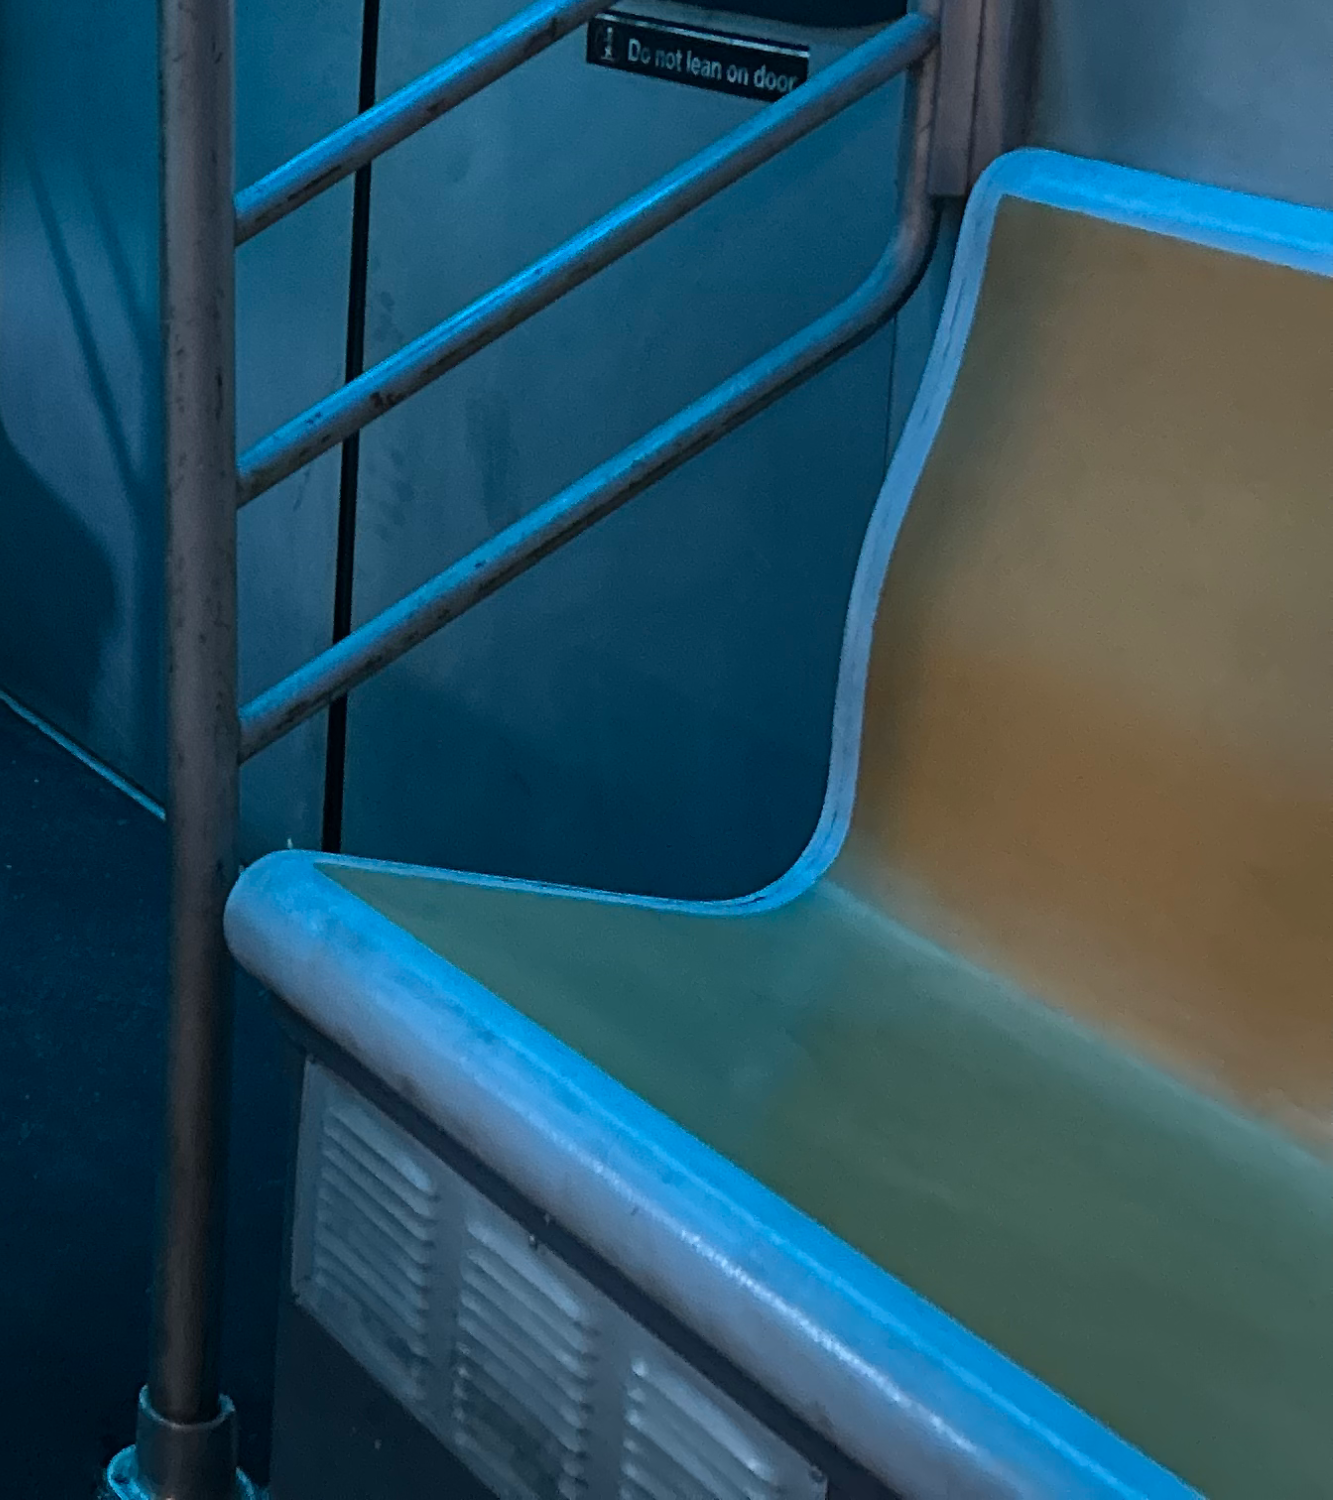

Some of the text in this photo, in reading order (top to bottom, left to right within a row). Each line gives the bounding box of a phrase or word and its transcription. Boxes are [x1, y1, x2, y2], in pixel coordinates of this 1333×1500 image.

[627, 37, 651, 64] Do
[654, 49, 682, 73] not
[686, 49, 722, 80] lean
[726, 63, 749, 86] on
